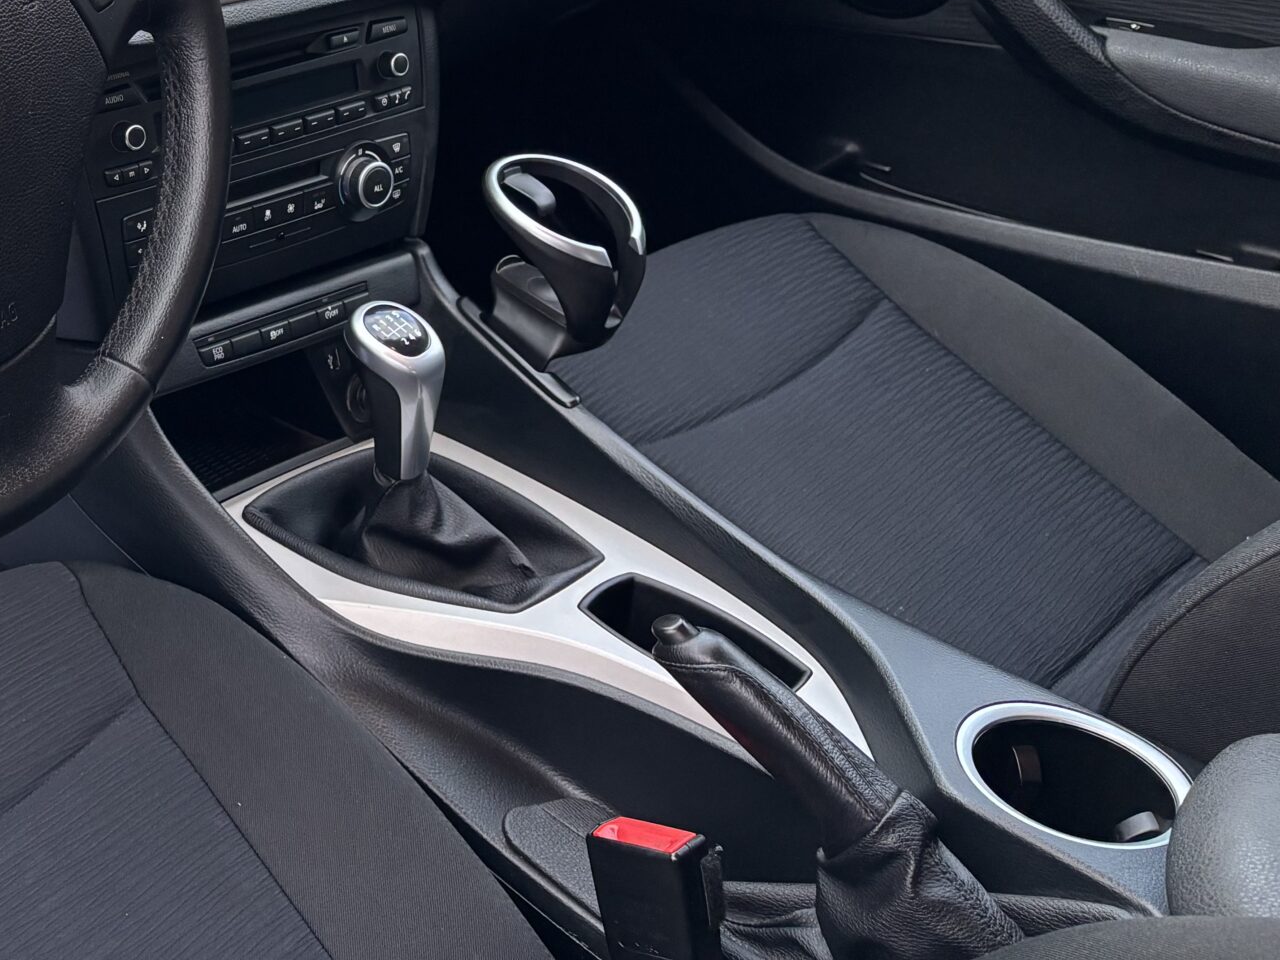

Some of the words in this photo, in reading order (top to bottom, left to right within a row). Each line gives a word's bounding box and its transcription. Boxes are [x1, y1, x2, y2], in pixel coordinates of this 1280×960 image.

[382, 24, 397, 34] MENU
[105, 94, 124, 105] AUDIO
[394, 165, 403, 175] A/C
[373, 183, 383, 193] ALL
[232, 223, 247, 234] AUTO
[400, 337, 410, 345] 2
[212, 346, 223, 355] ECO
[214, 352, 225, 361] PRO
